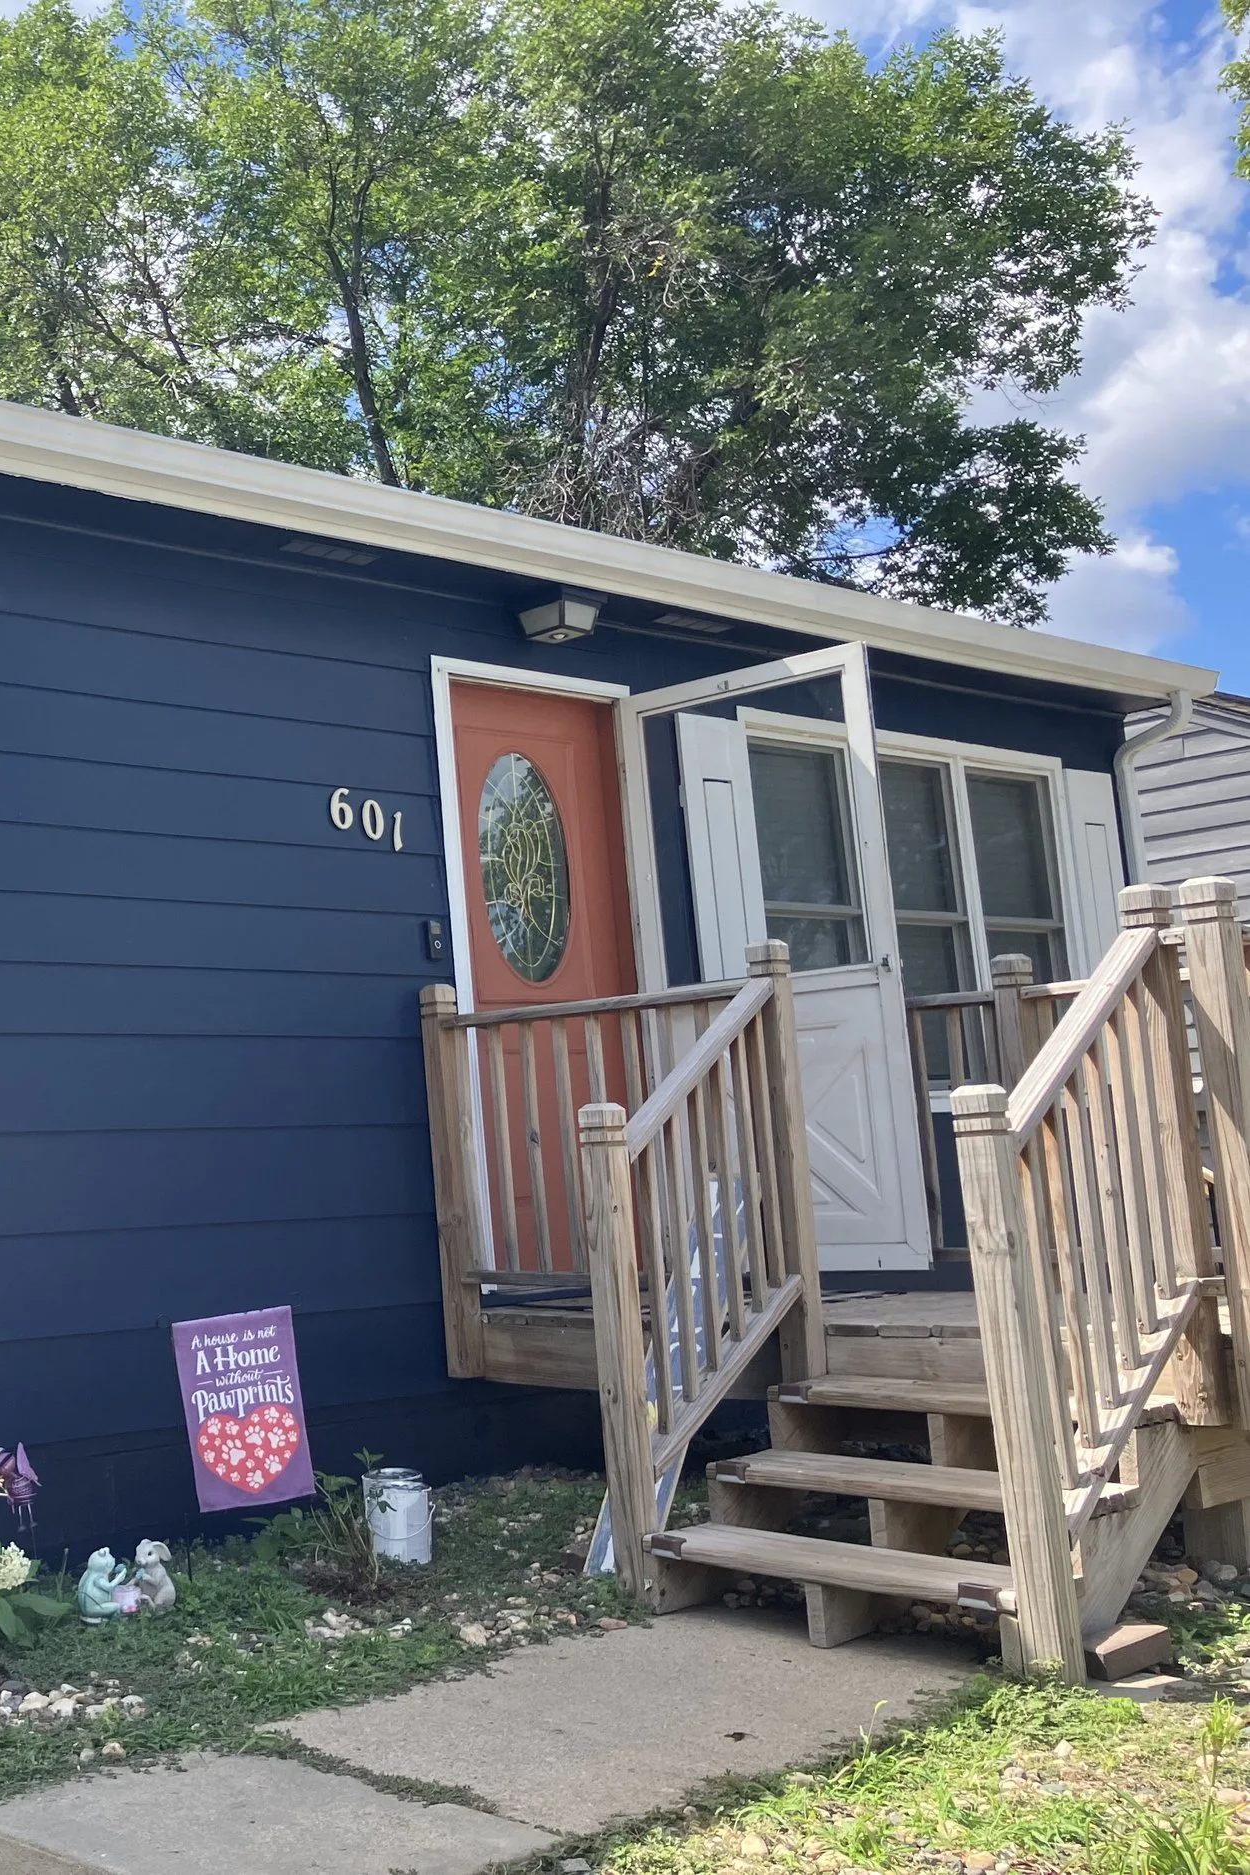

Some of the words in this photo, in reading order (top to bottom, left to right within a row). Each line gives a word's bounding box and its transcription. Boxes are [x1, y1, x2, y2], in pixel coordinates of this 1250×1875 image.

[330, 787, 403, 851] 601
[191, 1335, 202, 1349] A
[204, 1333, 238, 1346] house
[242, 1329, 255, 1341] is
[257, 1325, 277, 1339] not
[196, 1350, 211, 1375] A
[213, 1345, 280, 1371] Home
[215, 1368, 264, 1387] without
[191, 1375, 294, 1424] Pawprints
